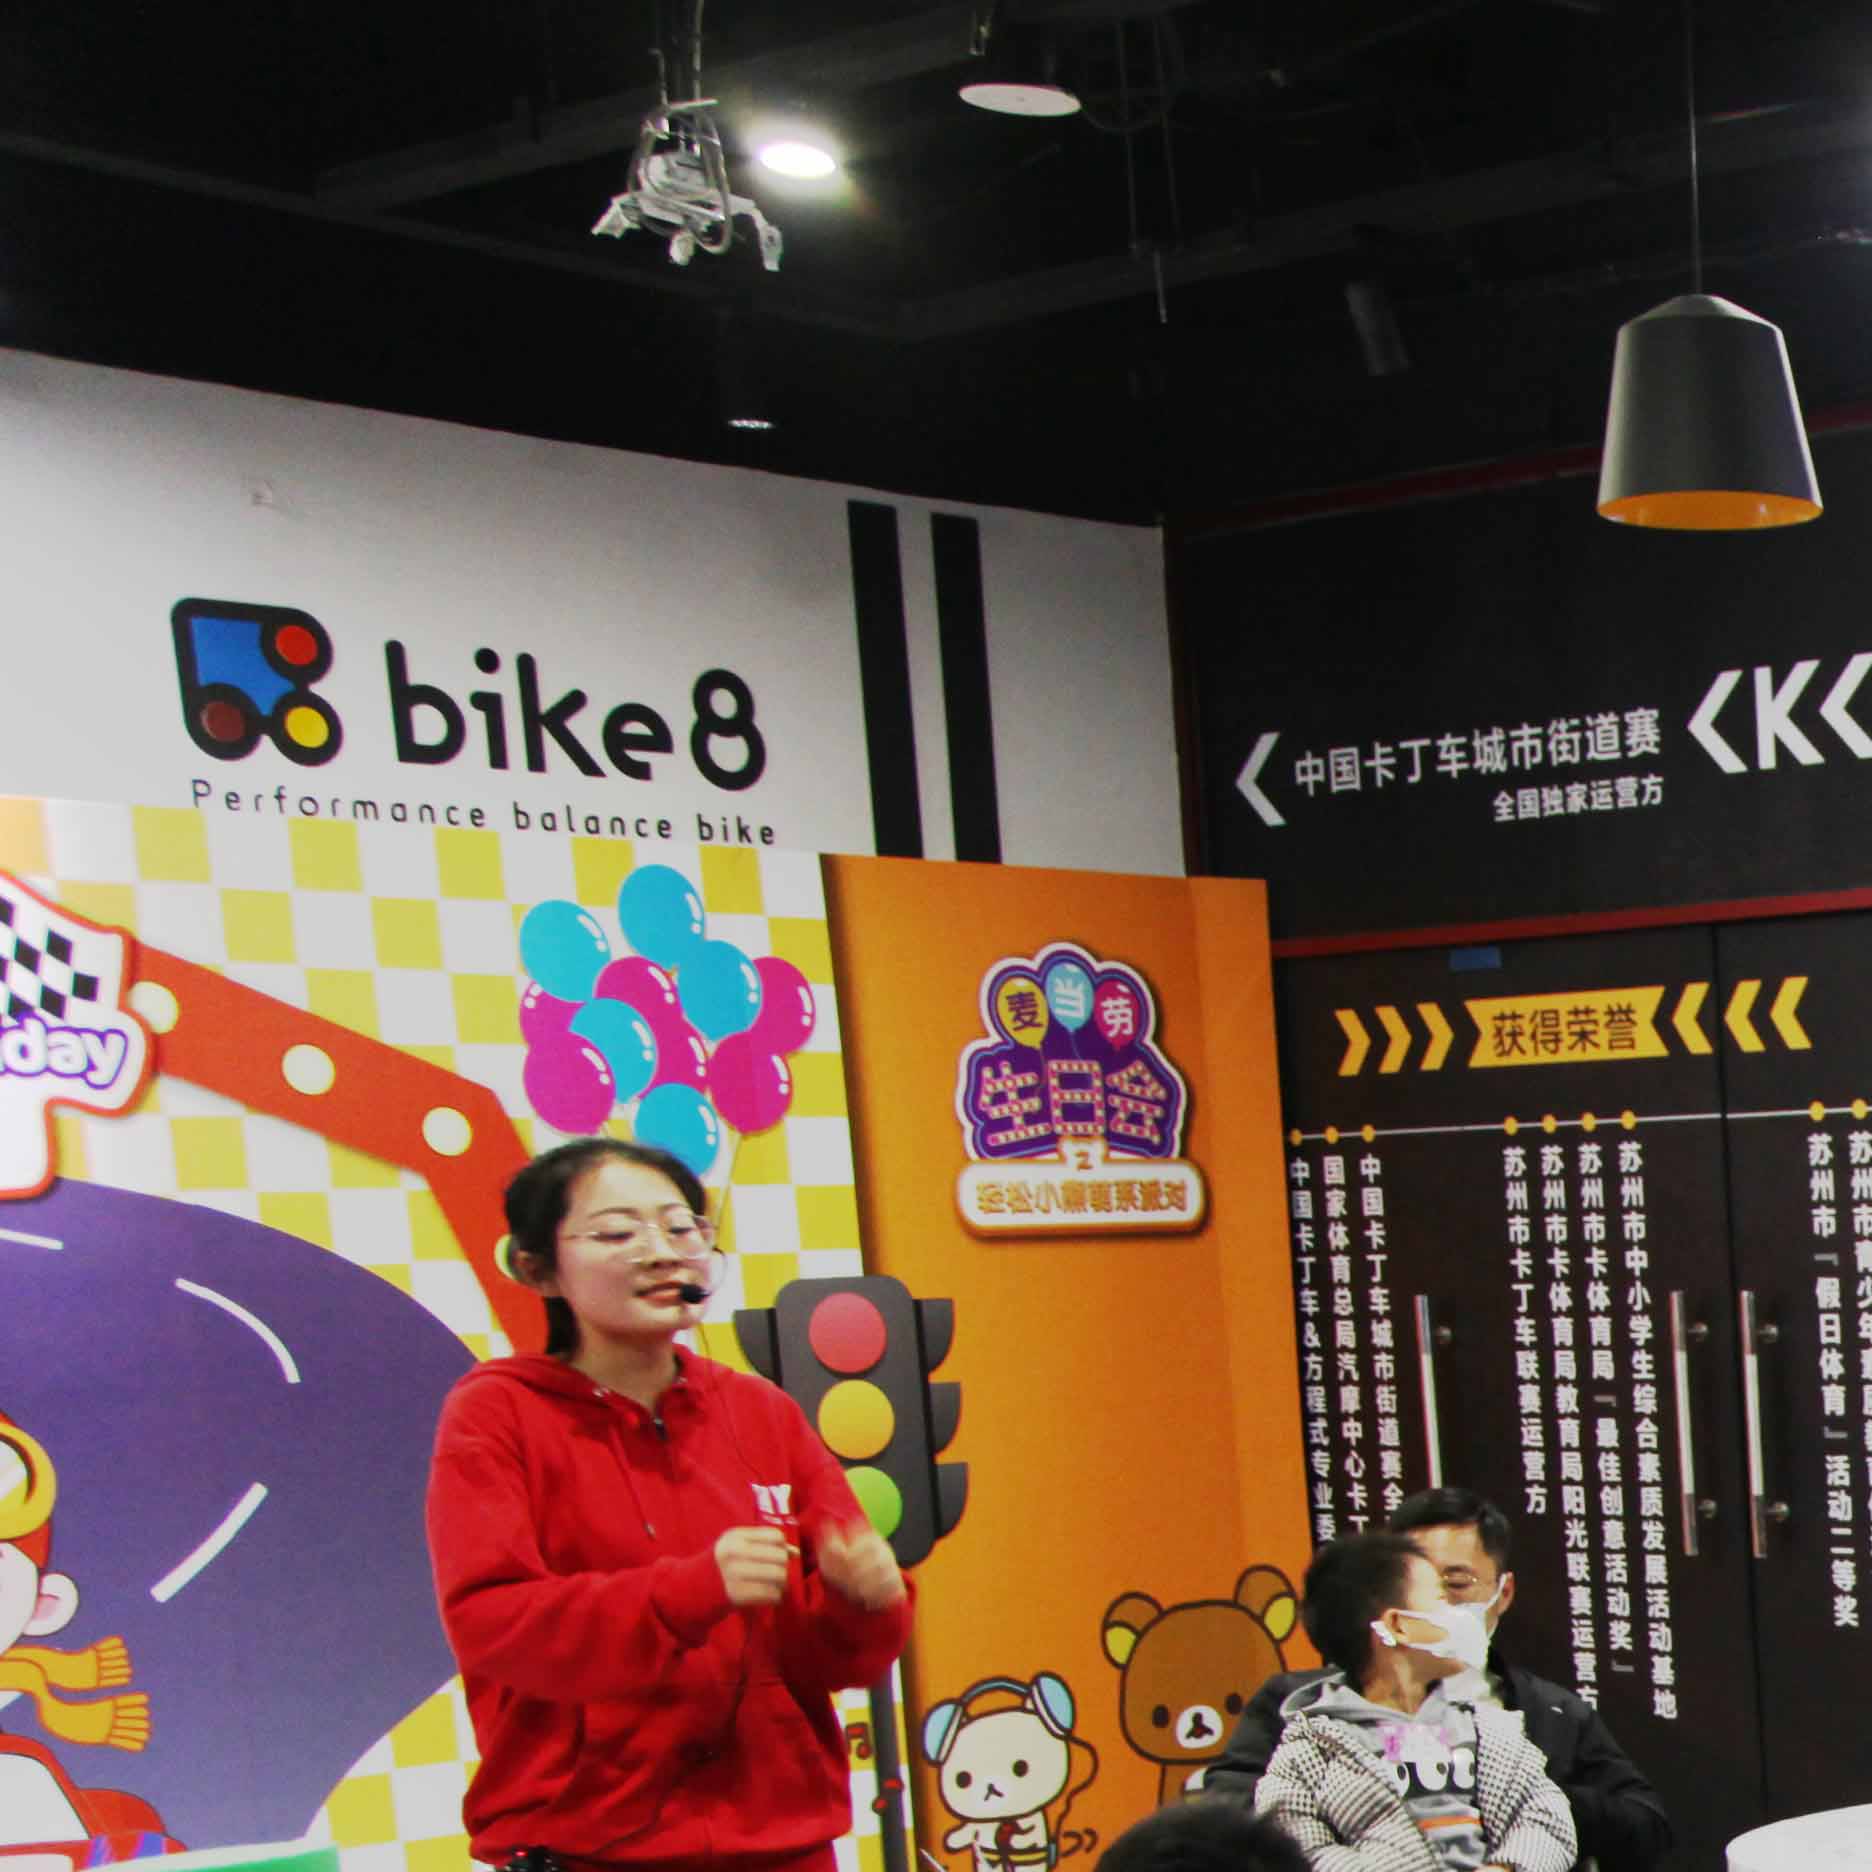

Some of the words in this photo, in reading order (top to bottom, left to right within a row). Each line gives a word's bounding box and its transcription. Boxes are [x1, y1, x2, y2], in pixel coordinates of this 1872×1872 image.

[1295, 707, 1661, 797] 中国卡丁车城市街道赛
[192, 780, 485, 828] Performance
[513, 803, 673, 839] balance
[697, 815, 775, 845] bike
[1493, 774, 1664, 822] 全国独家运营方
[1005, 978, 1135, 1037] 麦当劳
[1490, 1002, 1638, 1058] 获得荣誉
[0, 1012, 129, 1090] day
[977, 1060, 1167, 1146] 生日会
[1359, 1153, 1405, 1521] 中国卡丁车城市街道赛全
[1503, 1146, 1547, 1515] 苏州市卡丁车联赛运营方
[1618, 1141, 1678, 1719] 苏州市中小学生综合素质发展活动基地
